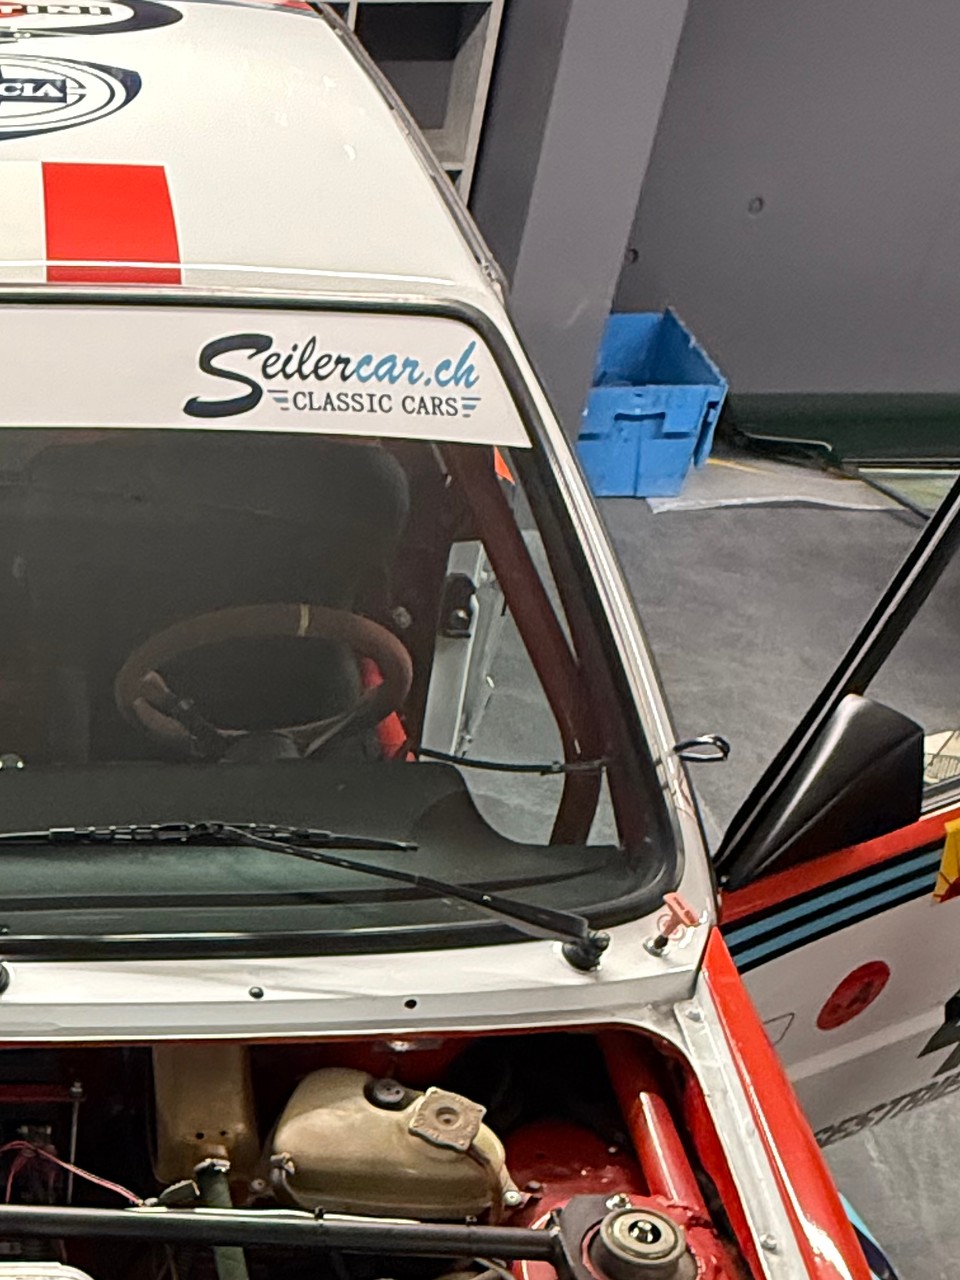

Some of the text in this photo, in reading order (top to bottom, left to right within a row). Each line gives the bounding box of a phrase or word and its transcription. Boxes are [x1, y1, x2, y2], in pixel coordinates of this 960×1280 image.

[182, 333, 480, 419] Seilercar.ch
[292, 391, 459, 418] CLASSIC CARS
